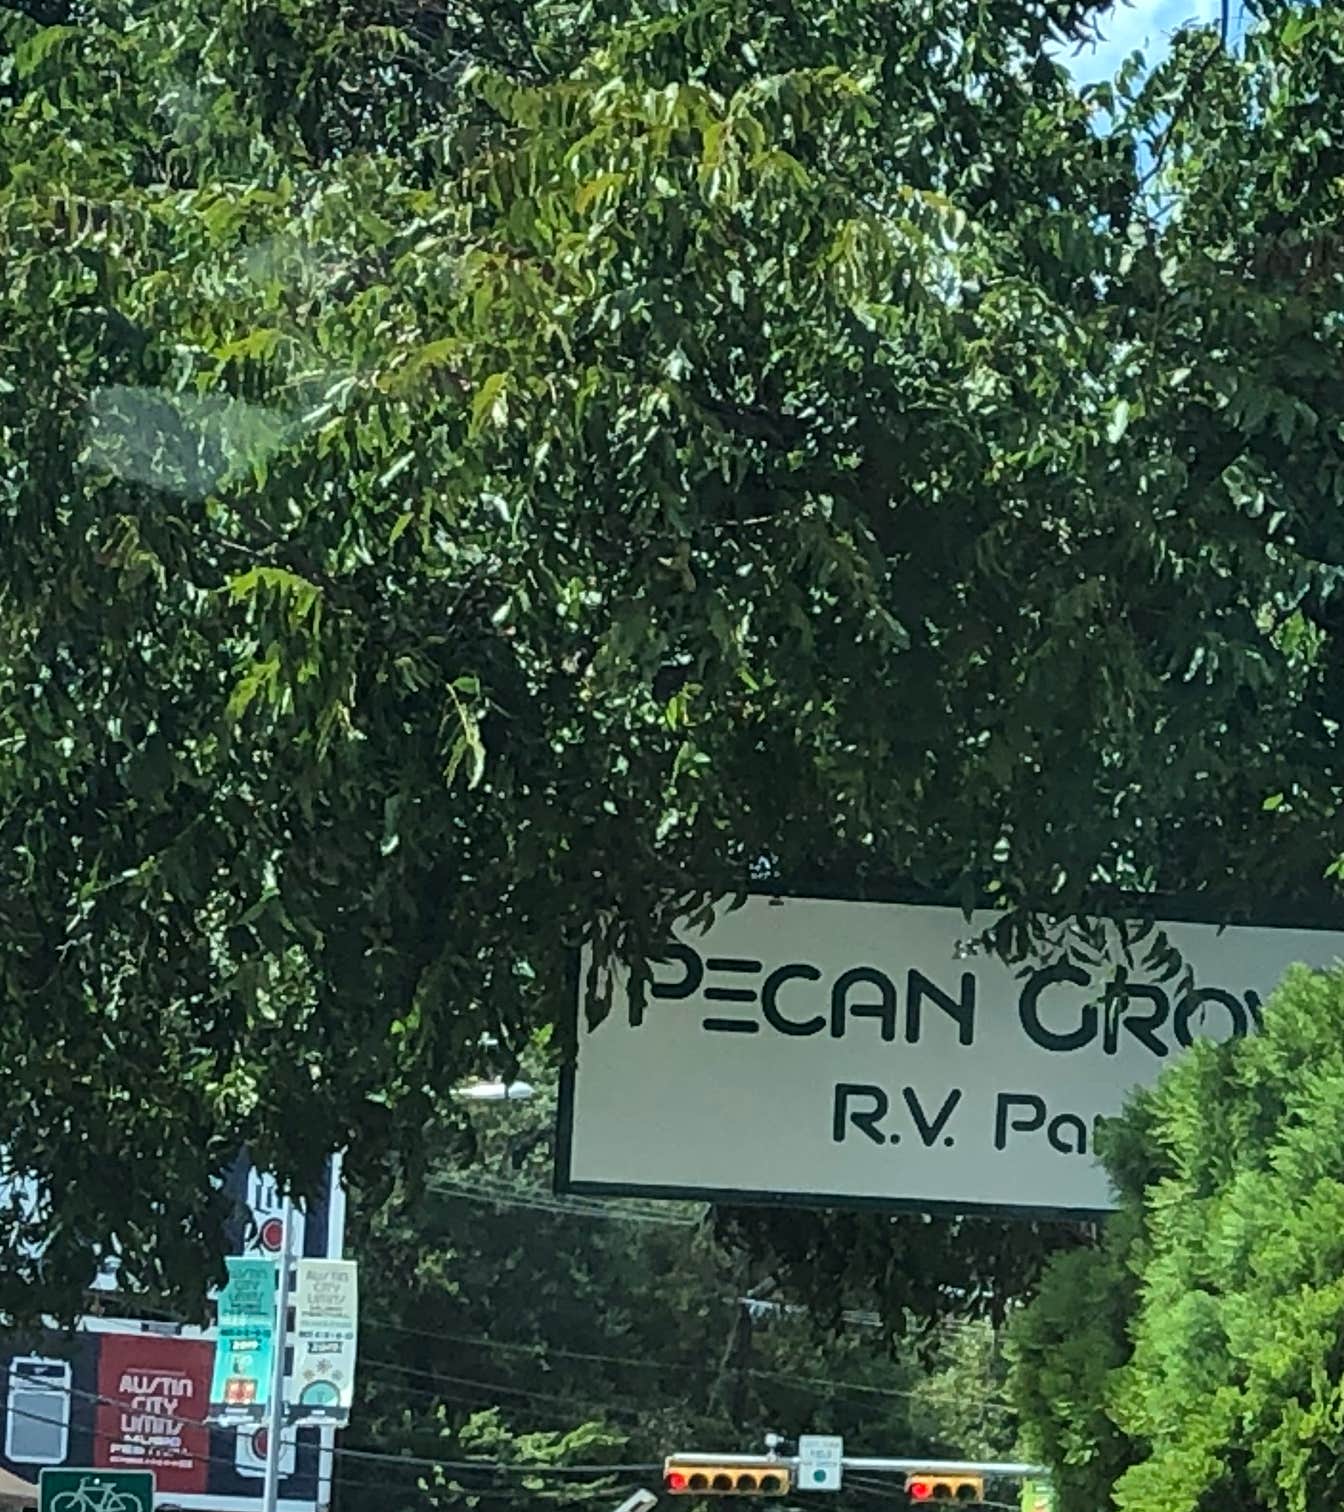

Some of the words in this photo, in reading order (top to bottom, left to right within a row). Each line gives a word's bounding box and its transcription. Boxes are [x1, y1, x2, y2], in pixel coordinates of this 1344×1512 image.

[628, 944, 976, 1046] PECAN
[832, 1083, 962, 1147] R.V.
[119, 1374, 194, 1398] AUSTIN
[131, 1396, 178, 1415] CITY
[120, 1413, 184, 1435] LIMITS
